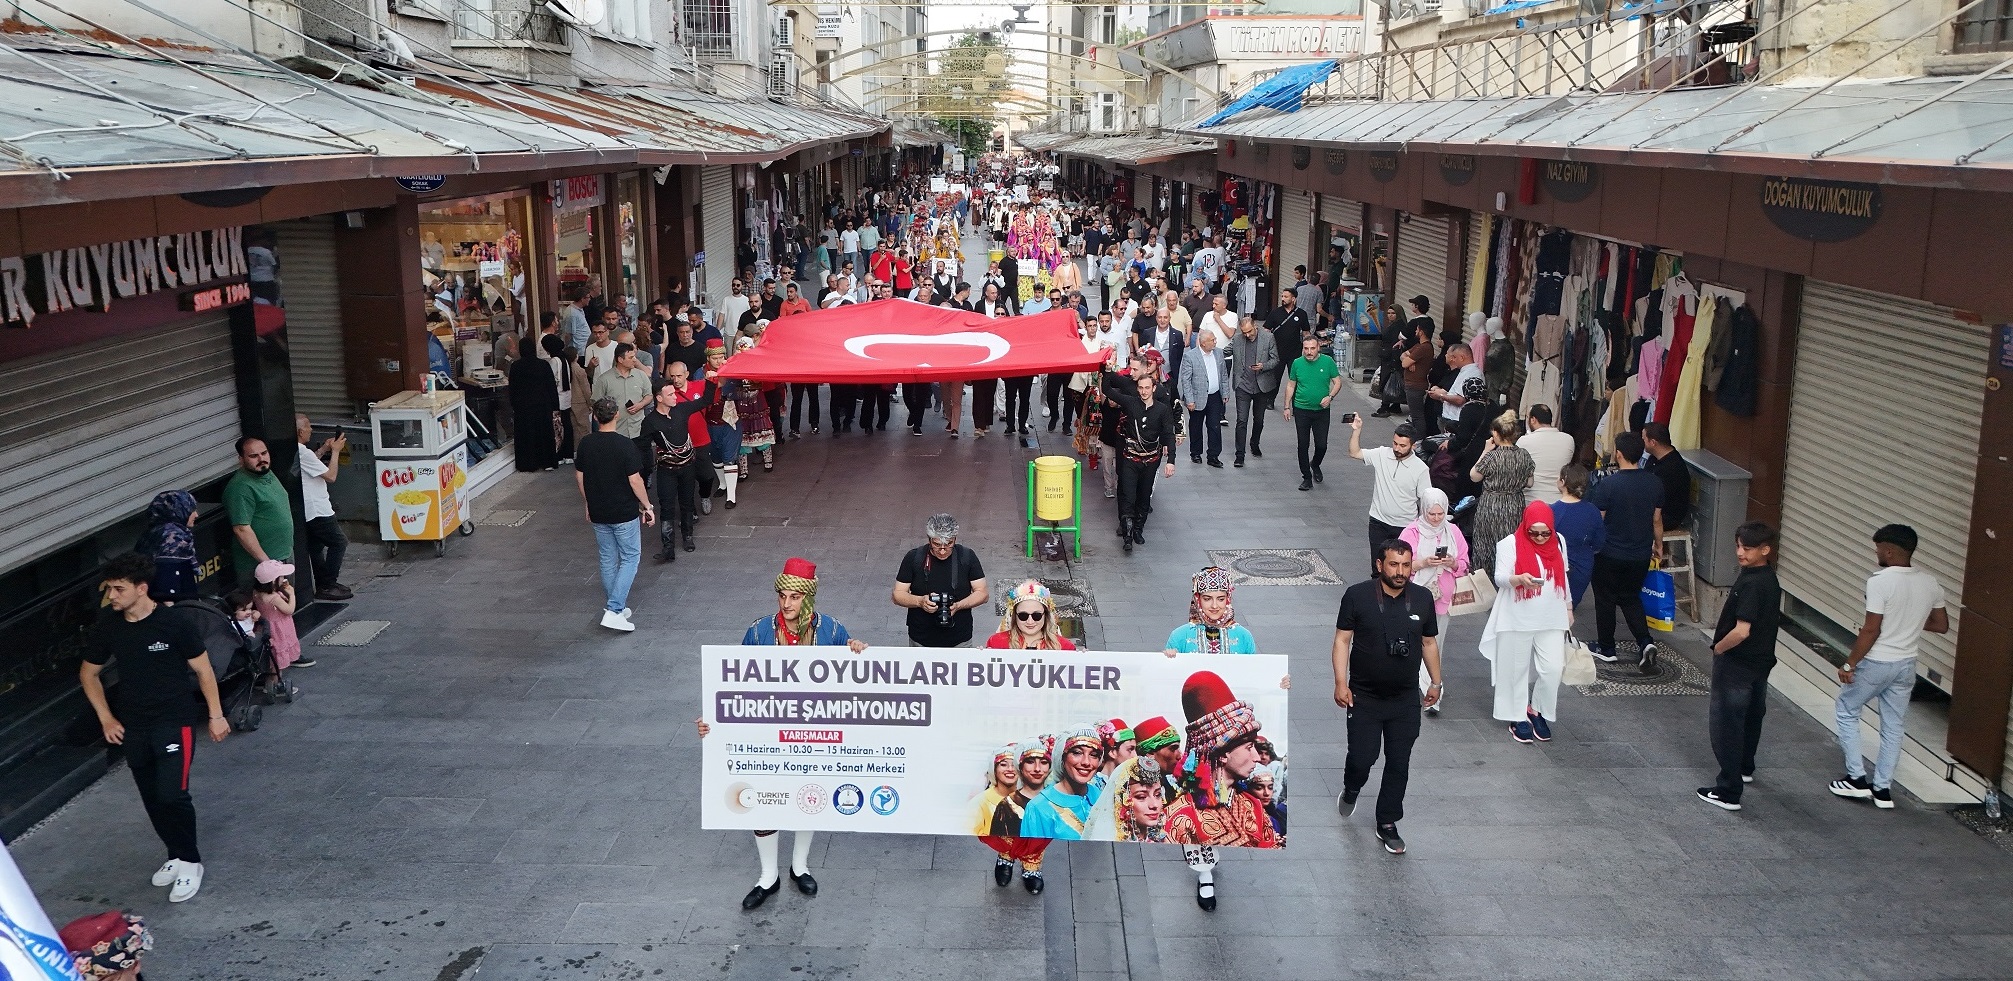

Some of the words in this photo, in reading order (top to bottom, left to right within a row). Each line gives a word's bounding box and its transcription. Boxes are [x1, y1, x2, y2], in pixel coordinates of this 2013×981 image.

[1287, 26, 1332, 53] MODA
[1547, 162, 1563, 182] NAZ
[1564, 161, 1588, 184] GİYİM
[568, 174, 598, 201] BOSCH
[1764, 176, 1800, 208] DOĞAN
[1801, 185, 1872, 218] KUYUMCULUK
[42, 226, 248, 313] KUYUMCULUK
[193, 289, 222, 312] SINCE
[380, 465, 416, 488] Cici
[721, 658, 801, 684] HALK
[808, 659, 958, 686] OYUNLARI
[967, 657, 1121, 691] BÜYÜKLER
[721, 694, 798, 719] TÜRKİYE
[802, 696, 926, 722] ŞAMPİYONASI
[783, 730, 840, 742] YARIŞMALAR
[733, 744, 744, 754] 14
[746, 744, 780, 754] Haziran
[788, 745, 812, 755] 10.30
[827, 745, 838, 755] 15
[840, 745, 873, 755] Haziran
[881, 746, 905, 756] 13.00
[735, 760, 780, 774] Şahinbey
[783, 761, 818, 774] Kongre
[836, 762, 863, 773] Sanat
[866, 763, 905, 774] Merkezi
